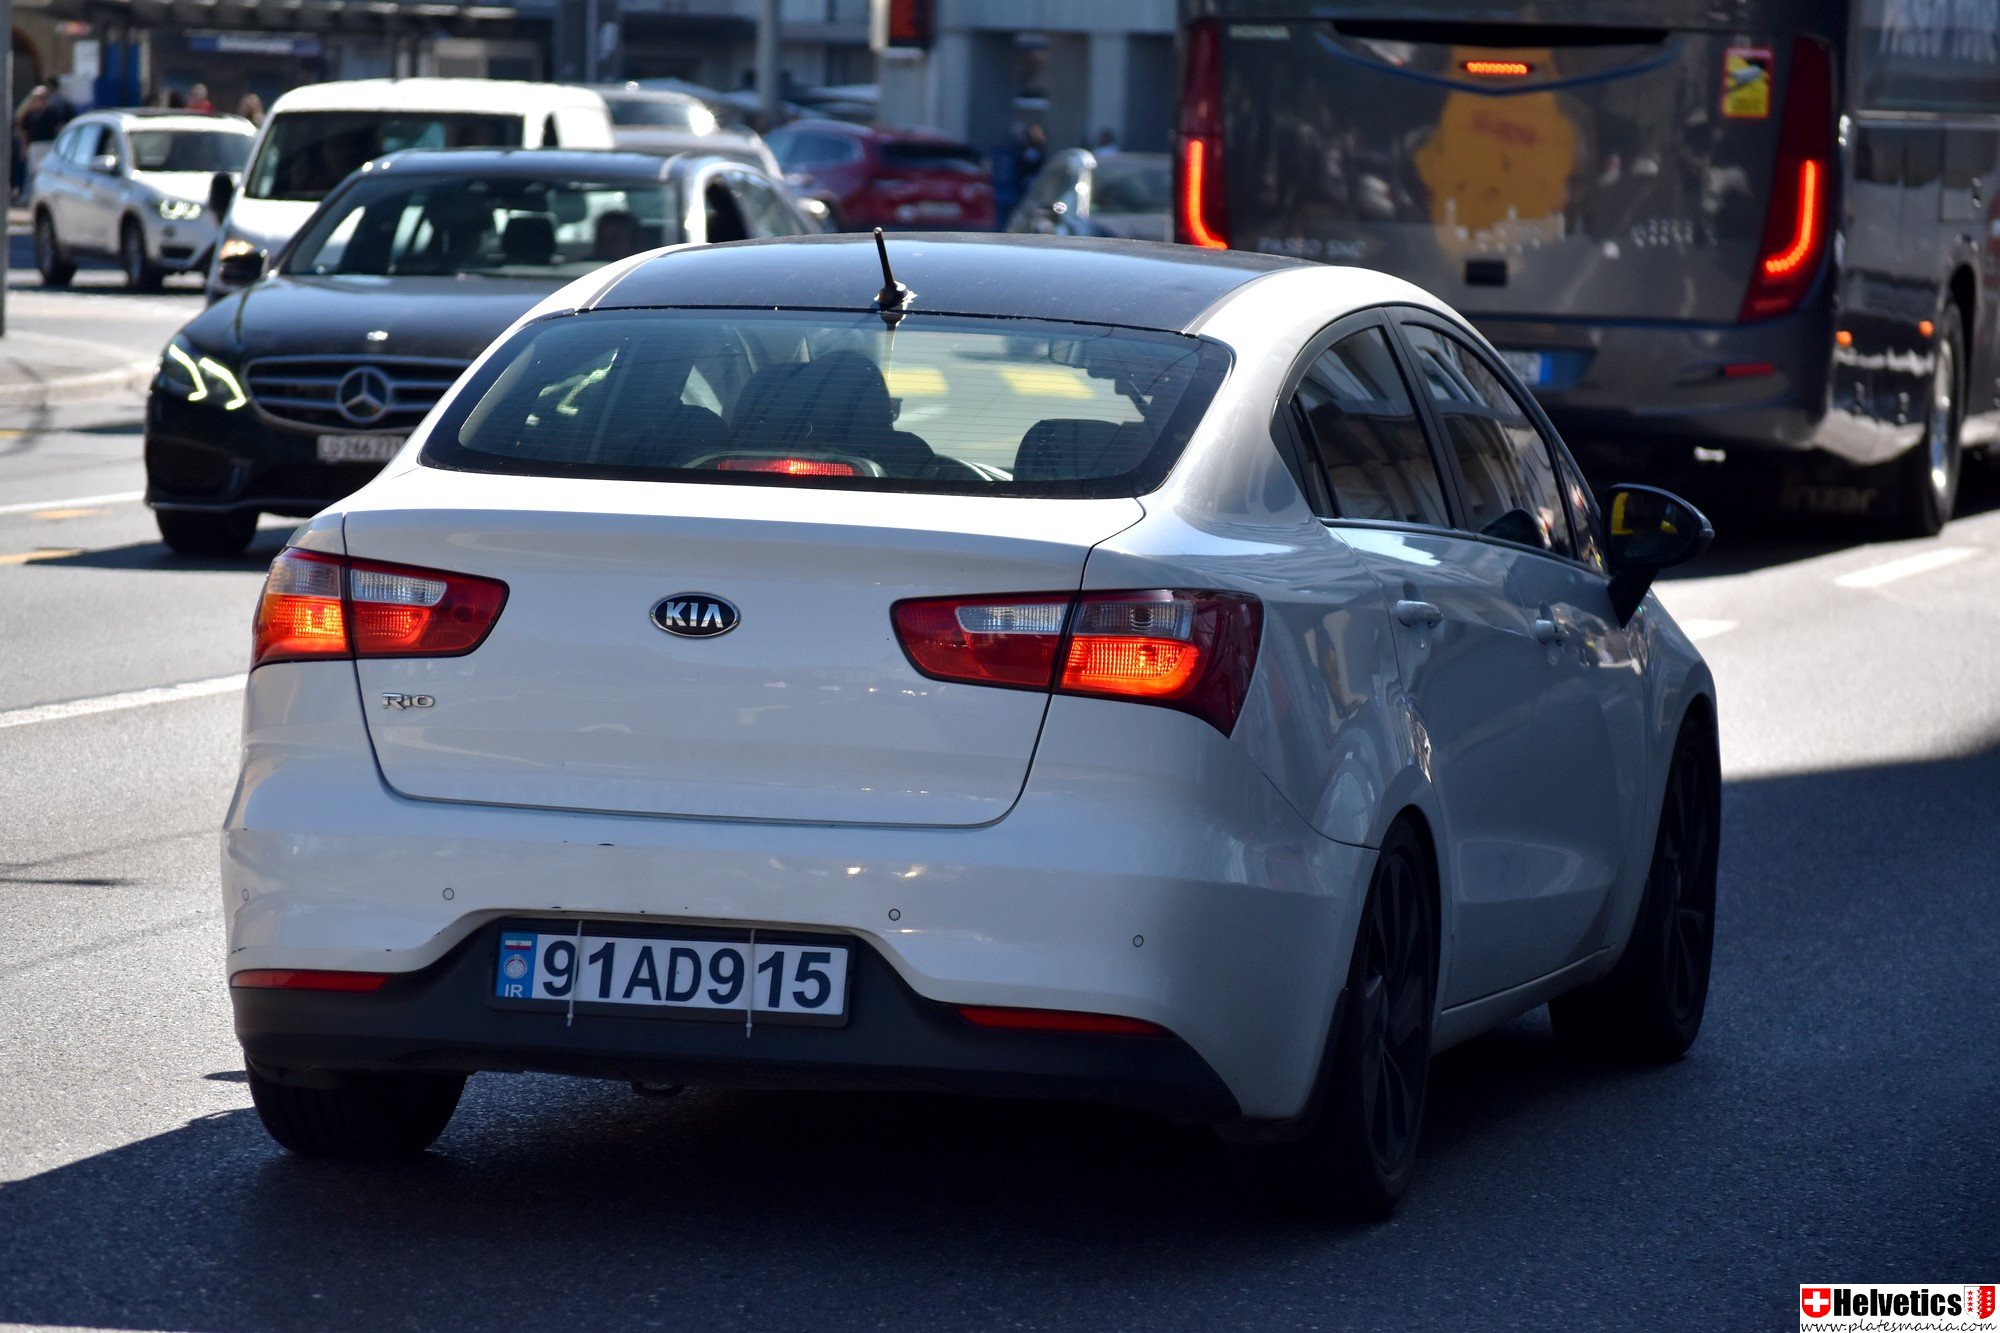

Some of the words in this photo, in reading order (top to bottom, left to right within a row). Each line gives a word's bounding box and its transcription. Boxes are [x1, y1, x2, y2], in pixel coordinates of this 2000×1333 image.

[666, 601, 724, 629] KIA
[542, 939, 832, 1009] 91AD915
[504, 984, 523, 998] IR
